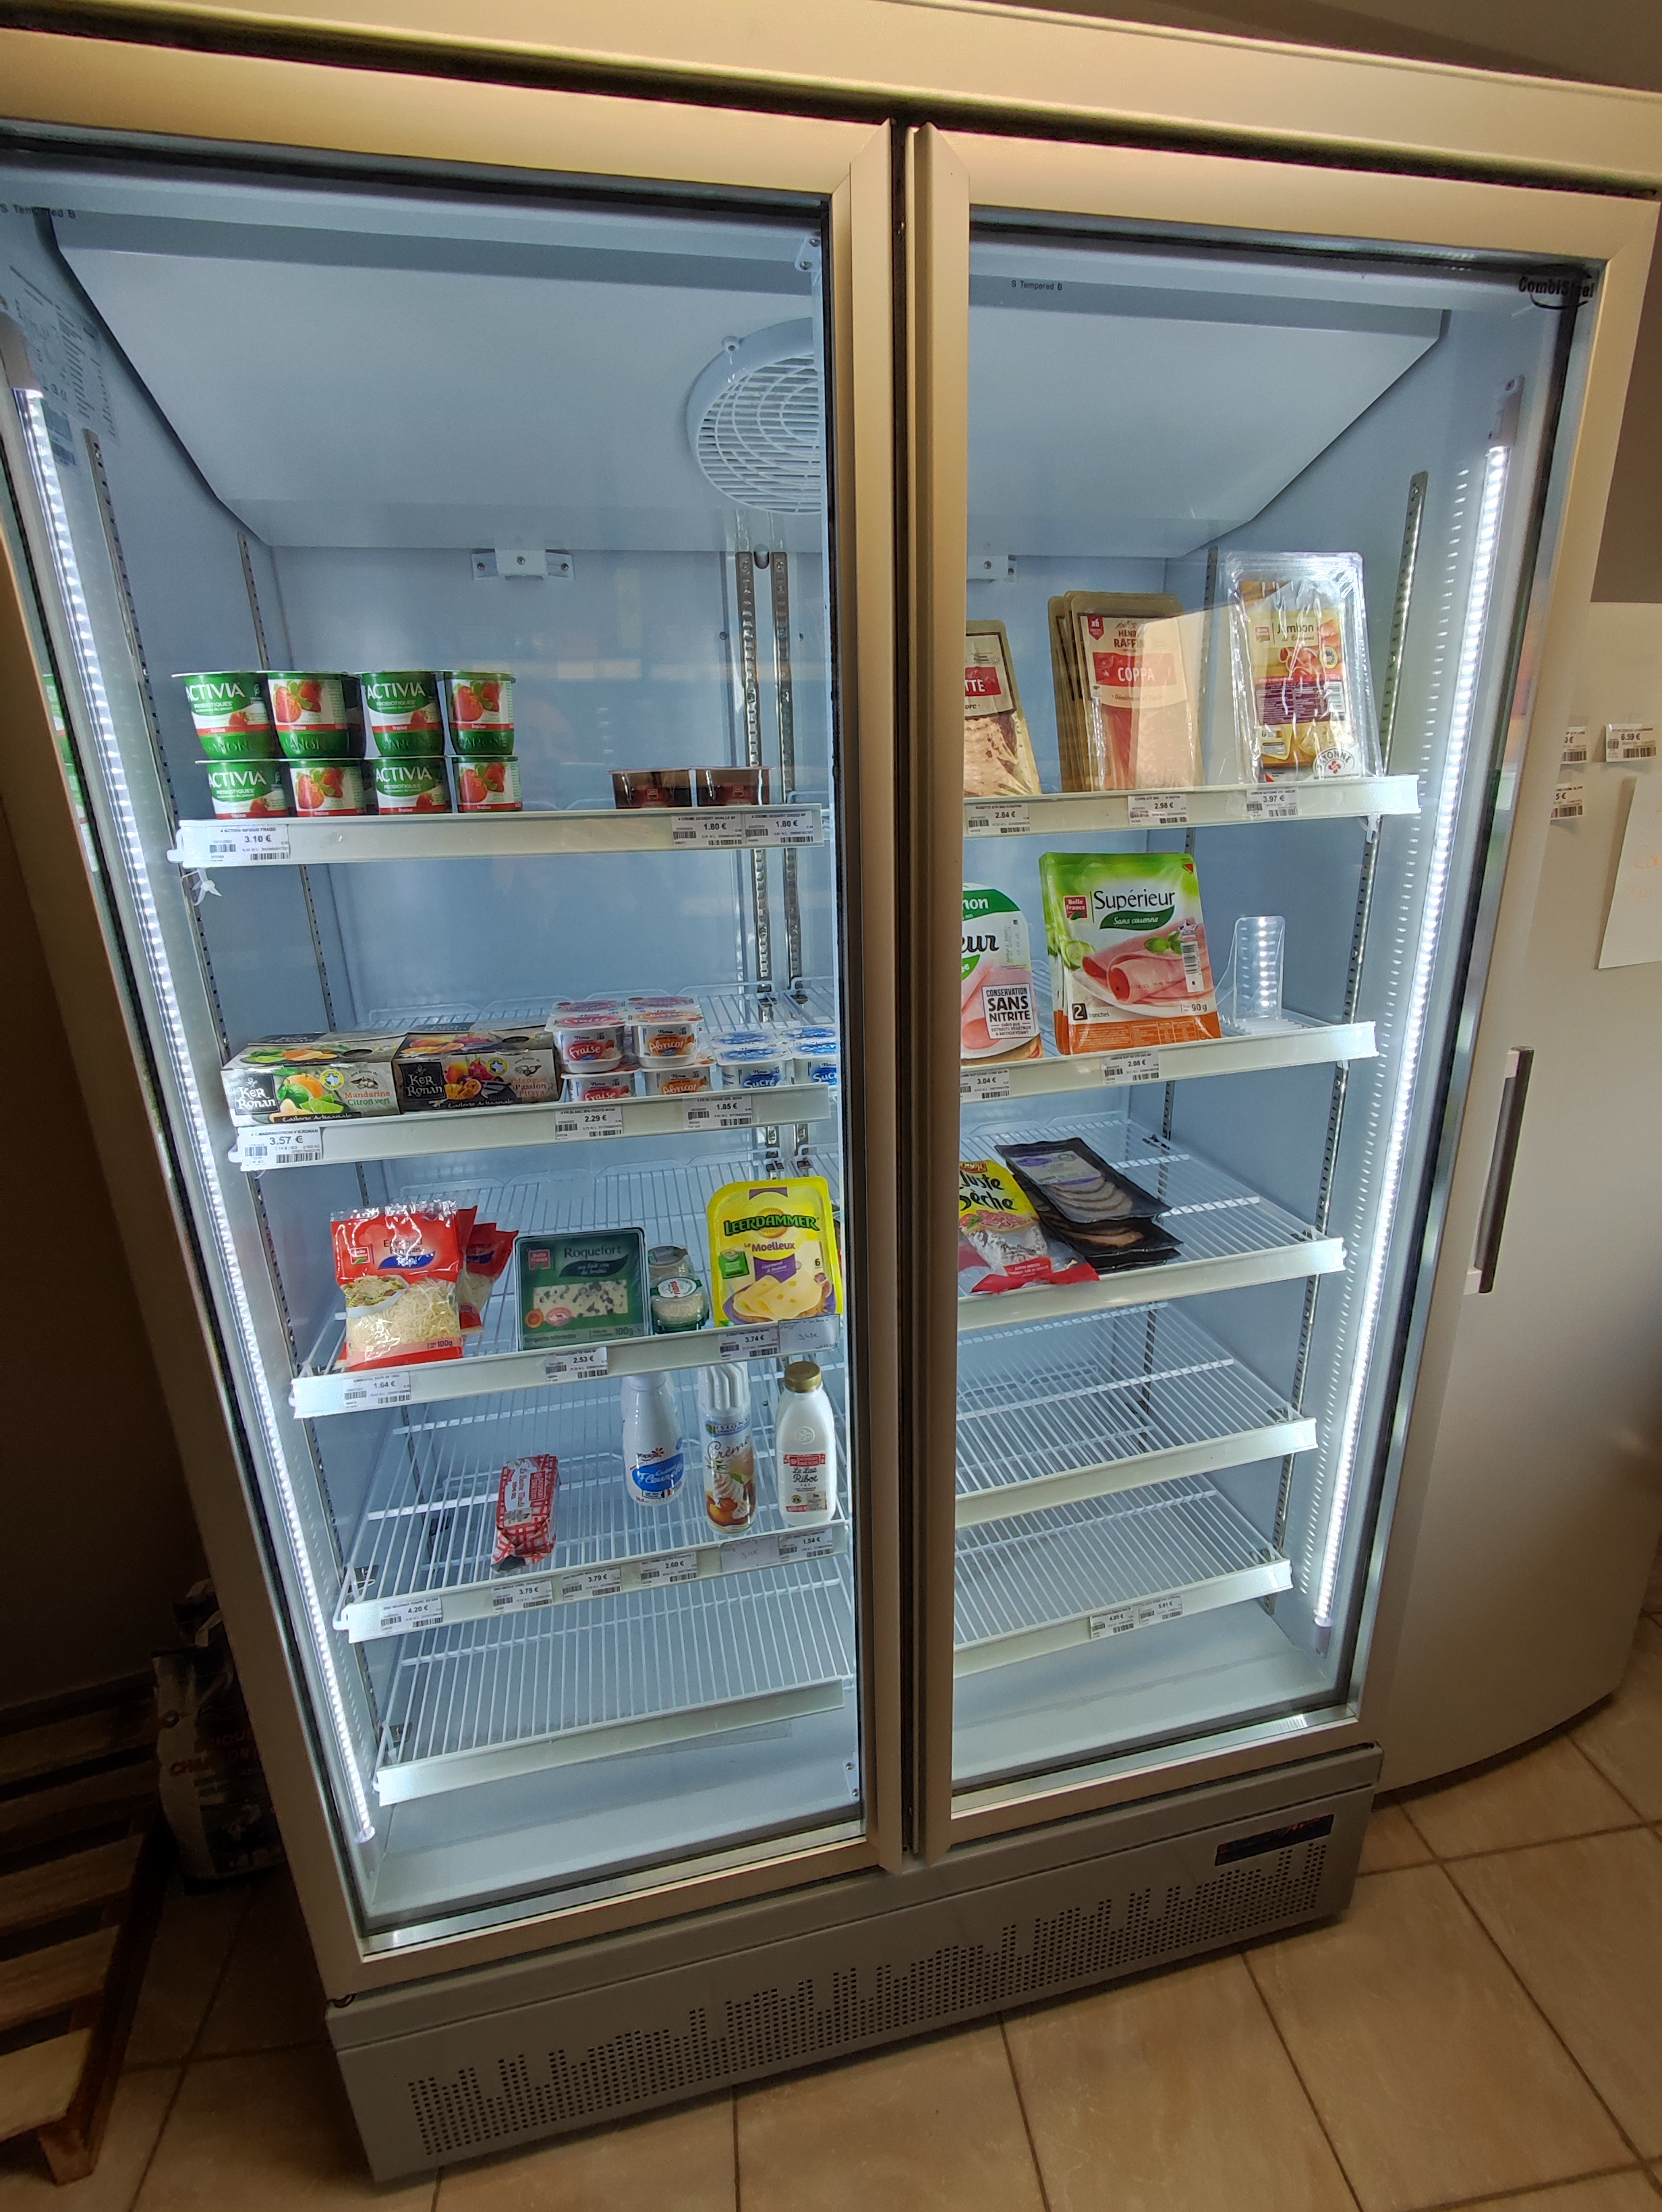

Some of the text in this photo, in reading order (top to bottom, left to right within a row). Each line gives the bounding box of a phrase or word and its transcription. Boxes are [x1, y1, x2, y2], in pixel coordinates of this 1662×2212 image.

[1117, 666, 1155, 682] COPPA
[366, 681, 426, 700] ACTIVIA
[376, 766, 432, 783] ACTIVIA
[1263, 795, 1278, 803] 3.97
[703, 822, 727, 831] 1.80 €
[244, 834, 273, 843] 3.10 €
[1093, 888, 1176, 910] Supérieur
[1113, 916, 1130, 925] Sans
[985, 987, 1028, 997] CONSERVATION
[987, 995, 1029, 1012] SANS
[1191, 1003, 1201, 1012] 90
[988, 1010, 1031, 1022] NITRITE
[1073, 1004, 1085, 1020] 2
[648, 1039, 684, 1052] Abricot
[743, 1076, 776, 1088] Sucré
[977, 1077, 991, 1085] 3.04
[662, 1083, 697, 1095] Abricot
[344, 1090, 391, 1099] Mandarine
[347, 1097, 391, 1107] Citron vert
[584, 1115, 600, 1123] 2.29
[269, 1135, 304, 1146] 3.57 €
[723, 1213, 821, 1237] LEERDAMMER
[751, 1241, 796, 1252] Moelleux
[564, 1246, 622, 1260] Roquefort
[814, 1258, 821, 1267] 6
[436, 1339, 453, 1348] 100g
[744, 1335, 759, 1343] 3.74
[573, 1356, 588, 1364] 2.53
[373, 1381, 389, 1390] 1.64
[792, 1474, 819, 1484] Ribot
[588, 1575, 602, 1583] 3.79
[519, 1588, 533, 1596] 3.79
[407, 1606, 422, 1614] 4.20
